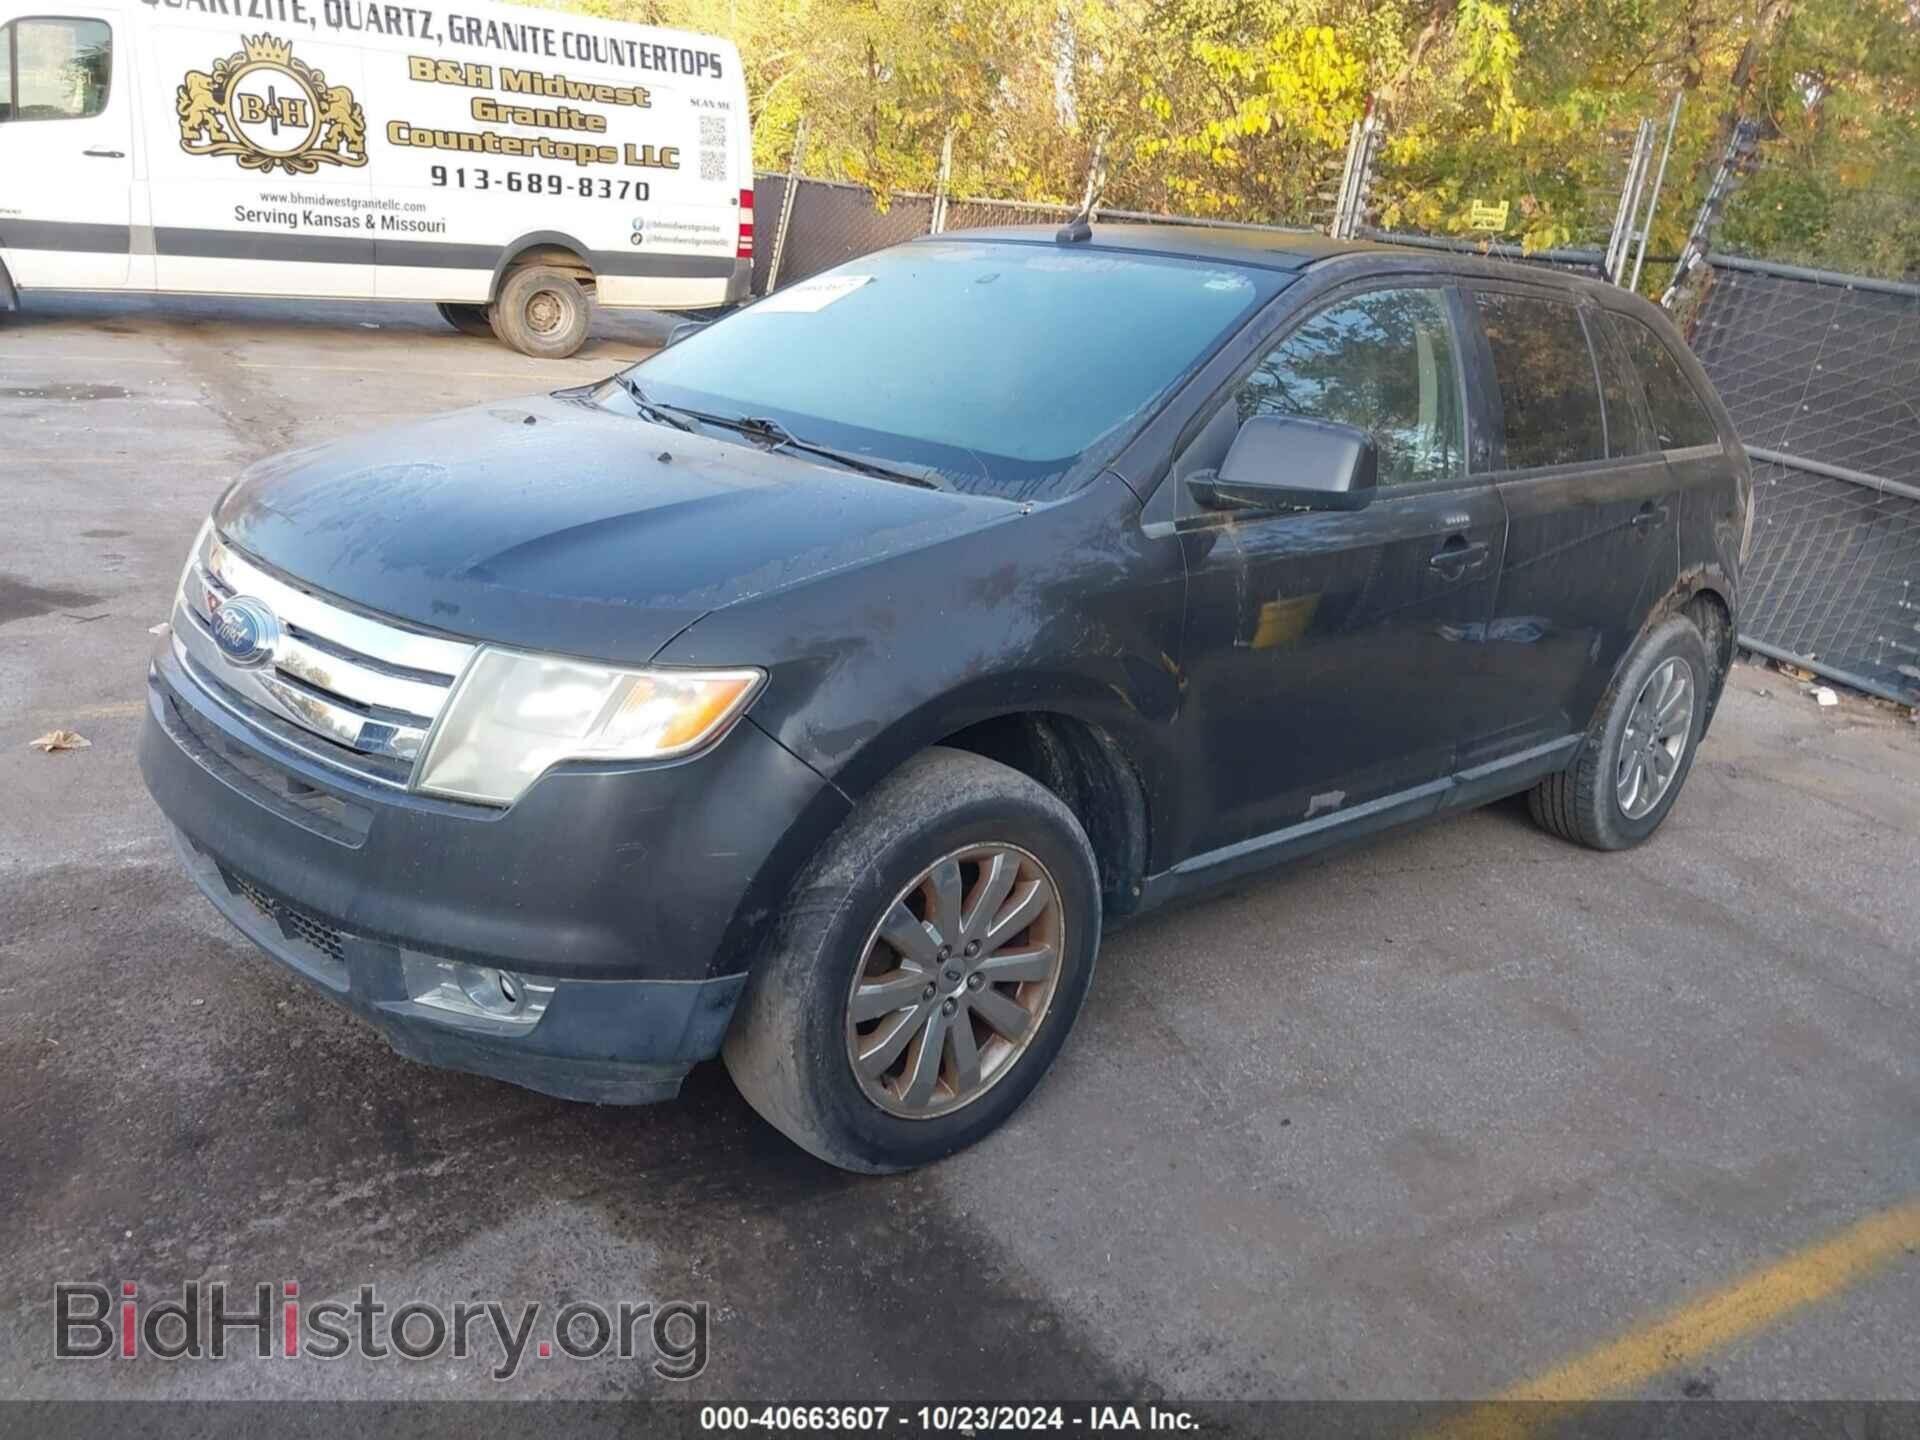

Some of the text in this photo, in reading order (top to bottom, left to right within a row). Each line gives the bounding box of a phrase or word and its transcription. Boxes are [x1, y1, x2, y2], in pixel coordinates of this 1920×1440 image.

[140, 0, 724, 79] TZITE, QUARTZ, GRANITE COUNTERTOPS
[408, 55, 652, 109] B&H Midwest
[471, 96, 607, 133] Granite
[386, 119, 680, 170] Countertops LLC
[259, 191, 427, 213] www.bhmidwestgranitellc.com
[430, 164, 651, 202] 913-689-8370
[234, 204, 447, 234] Serving Kansas & Missouri
